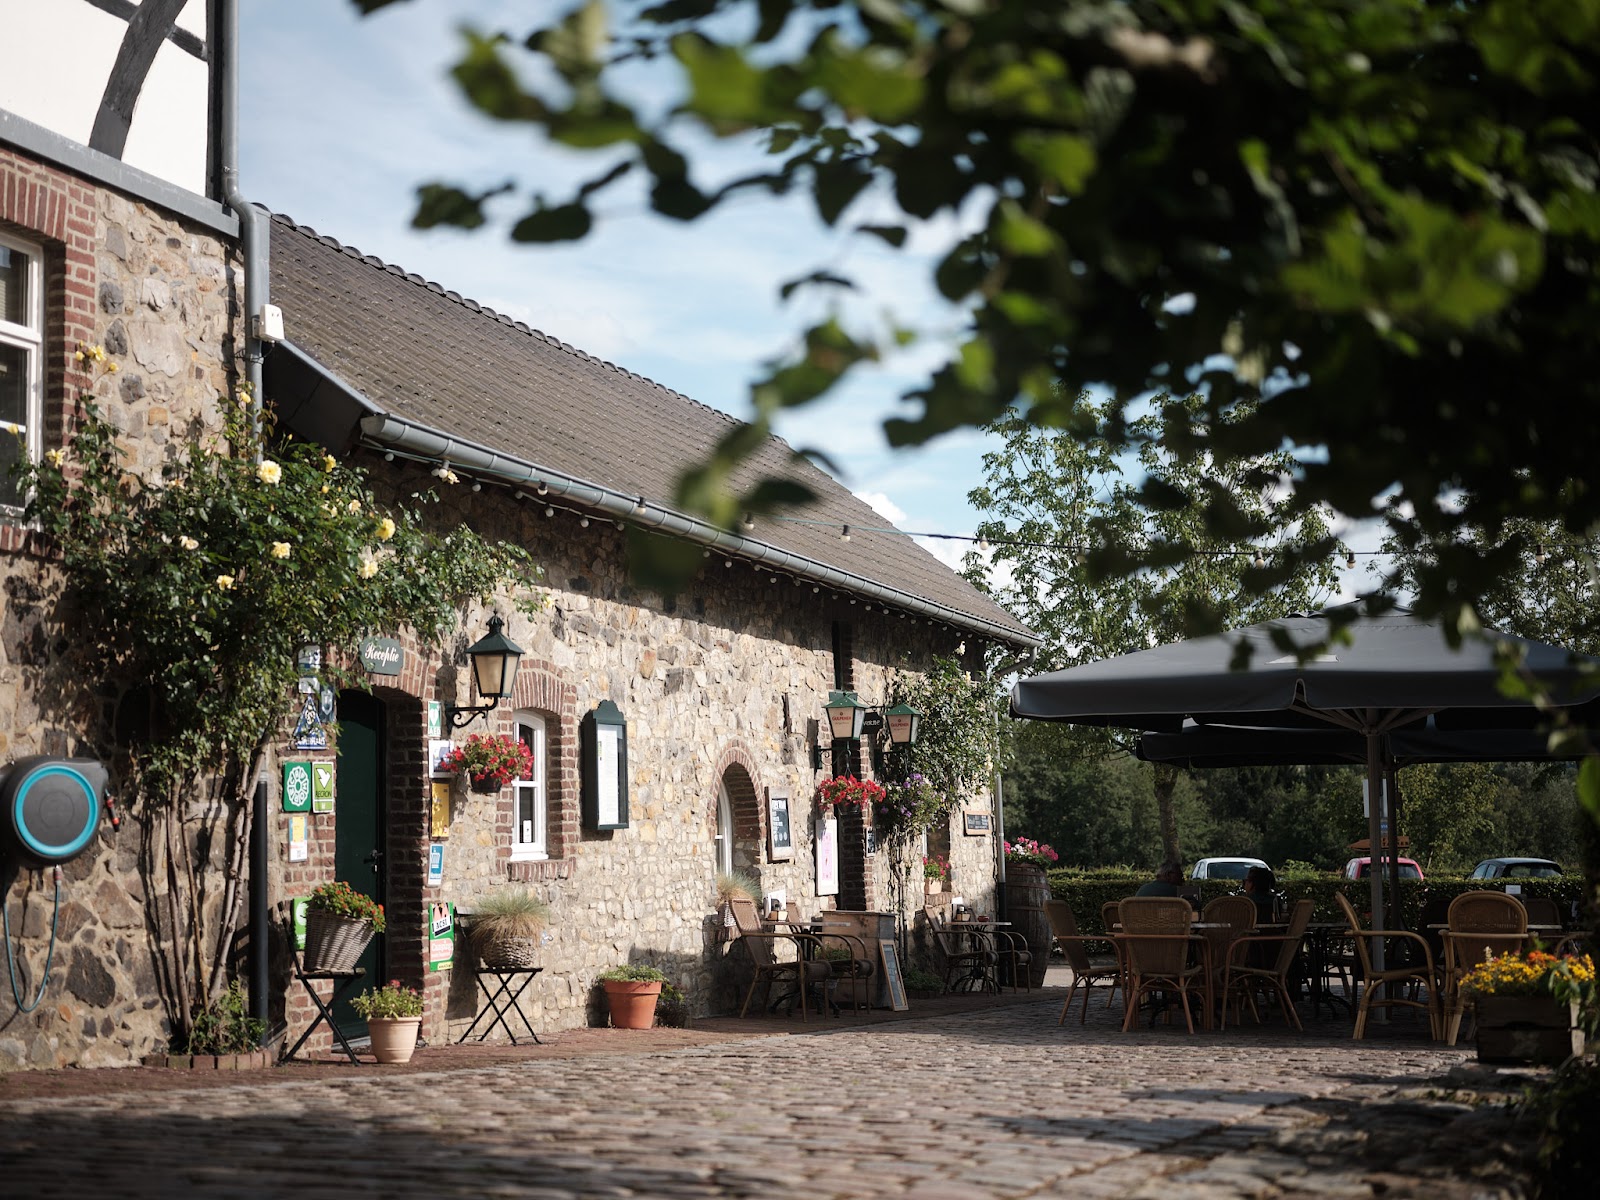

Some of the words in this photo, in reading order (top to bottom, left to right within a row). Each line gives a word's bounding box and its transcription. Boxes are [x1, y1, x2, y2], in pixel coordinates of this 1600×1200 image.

[364, 642, 400, 667] Receptie
[428, 727, 441, 735] AED
[436, 919, 447, 929] ACSI
